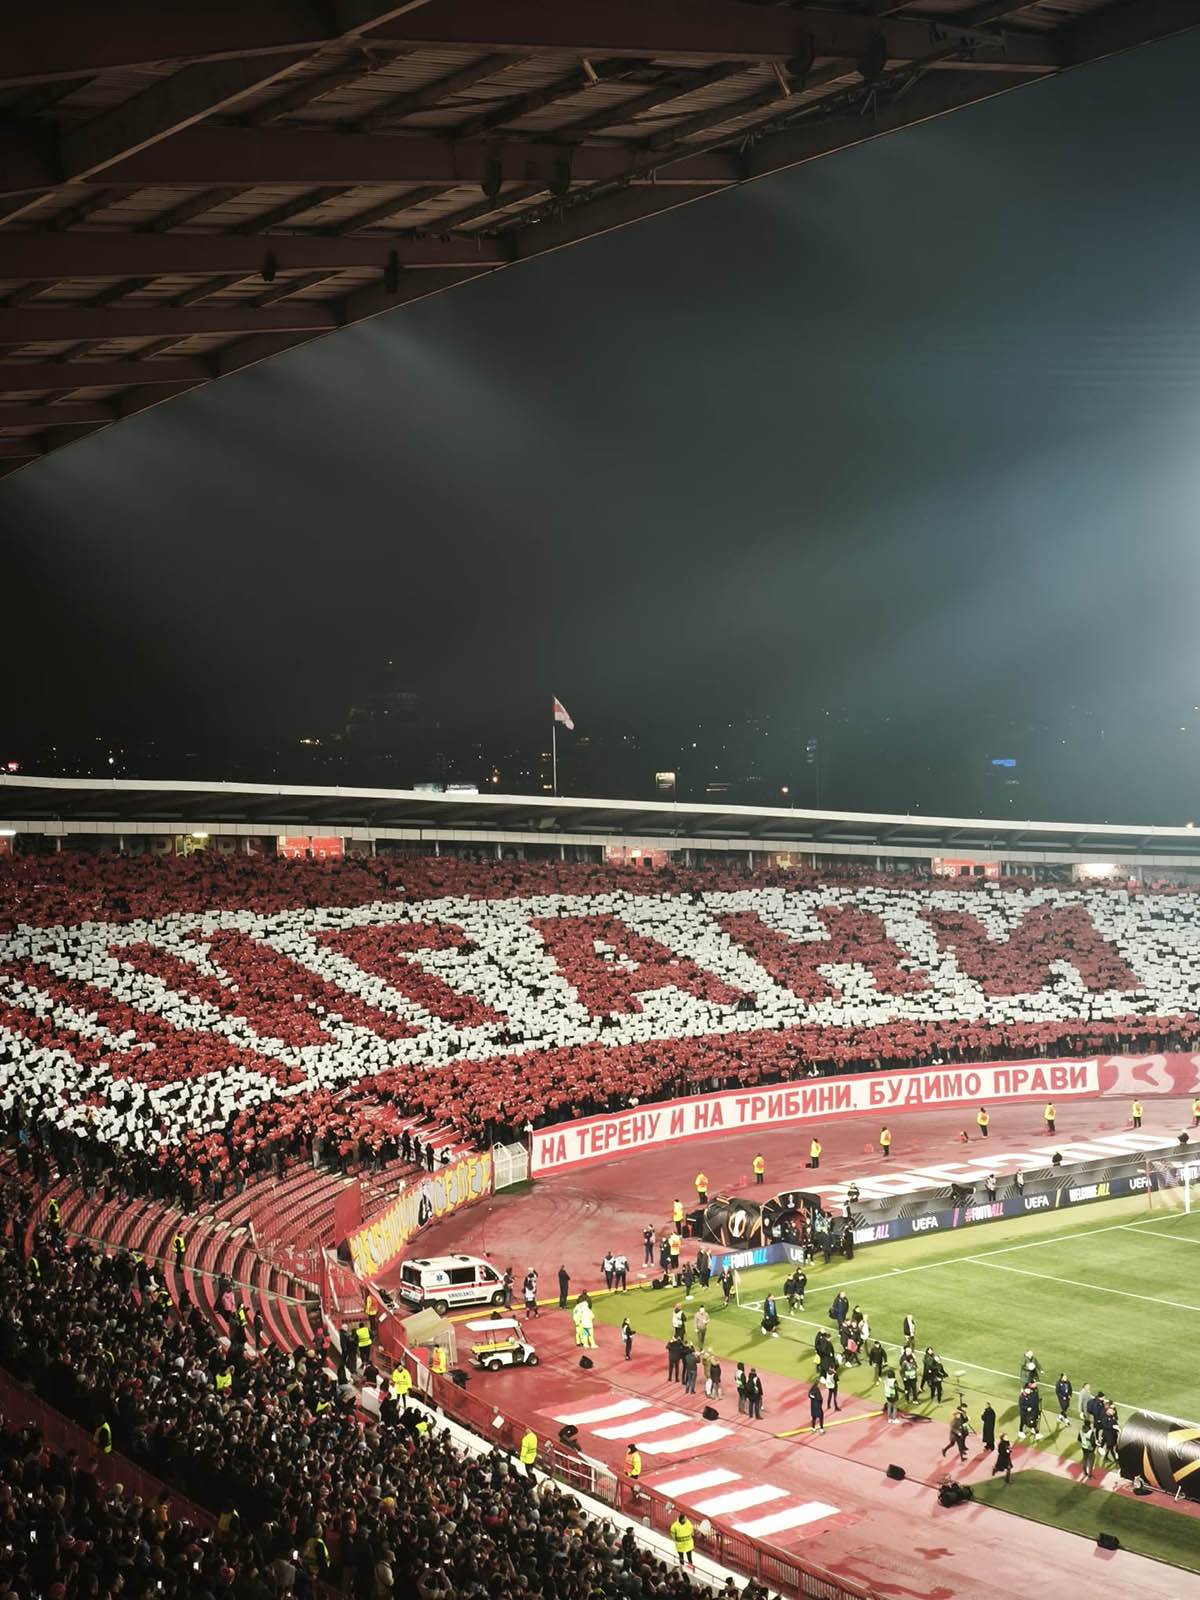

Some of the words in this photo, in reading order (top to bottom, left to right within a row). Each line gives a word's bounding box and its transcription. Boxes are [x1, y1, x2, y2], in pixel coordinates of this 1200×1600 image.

[541, 1137, 567, 1165] НА
[577, 1113, 661, 1154] ТЕРЕНУ
[670, 1108, 684, 1134] И
[695, 1101, 724, 1129] НА
[869, 1073, 981, 1104] БУДИМО
[994, 1066, 1088, 1092] ПРАВИ
[912, 1215, 939, 1232] UEFA
[1025, 1195, 1050, 1210] UEFA
[1129, 1176, 1152, 1190] UEFA
